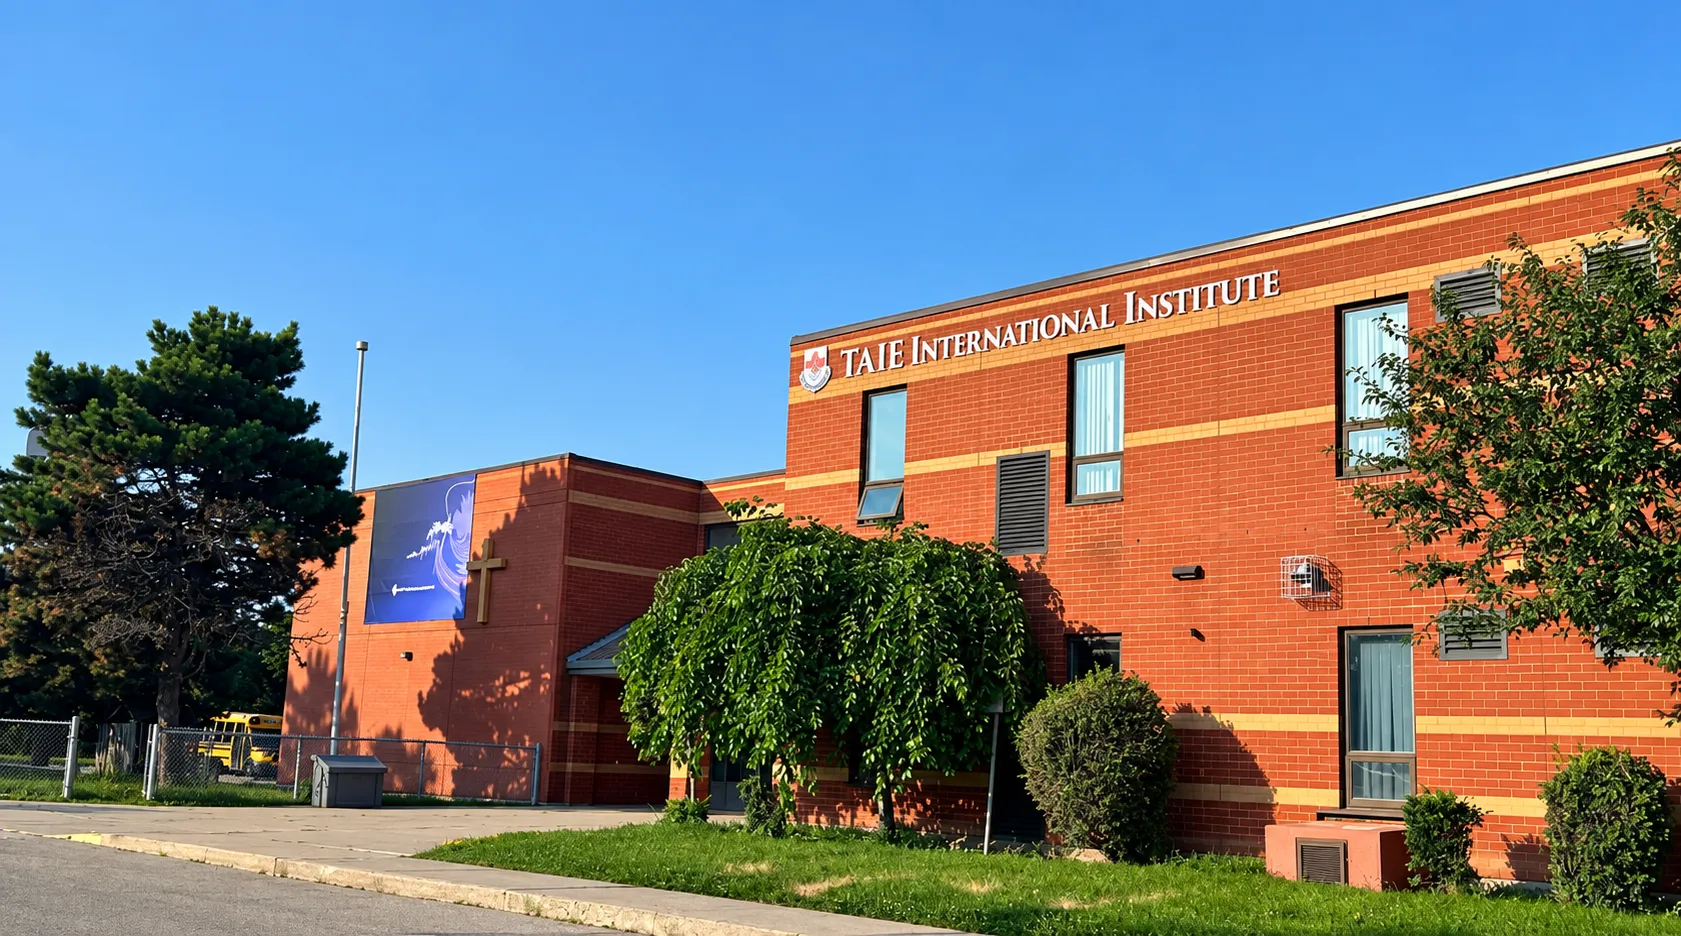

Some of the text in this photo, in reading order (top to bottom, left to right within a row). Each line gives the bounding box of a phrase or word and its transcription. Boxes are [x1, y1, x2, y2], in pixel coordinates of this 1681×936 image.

[841, 270, 1280, 378] TAIE INTERNATIONAL INSTITUTE
